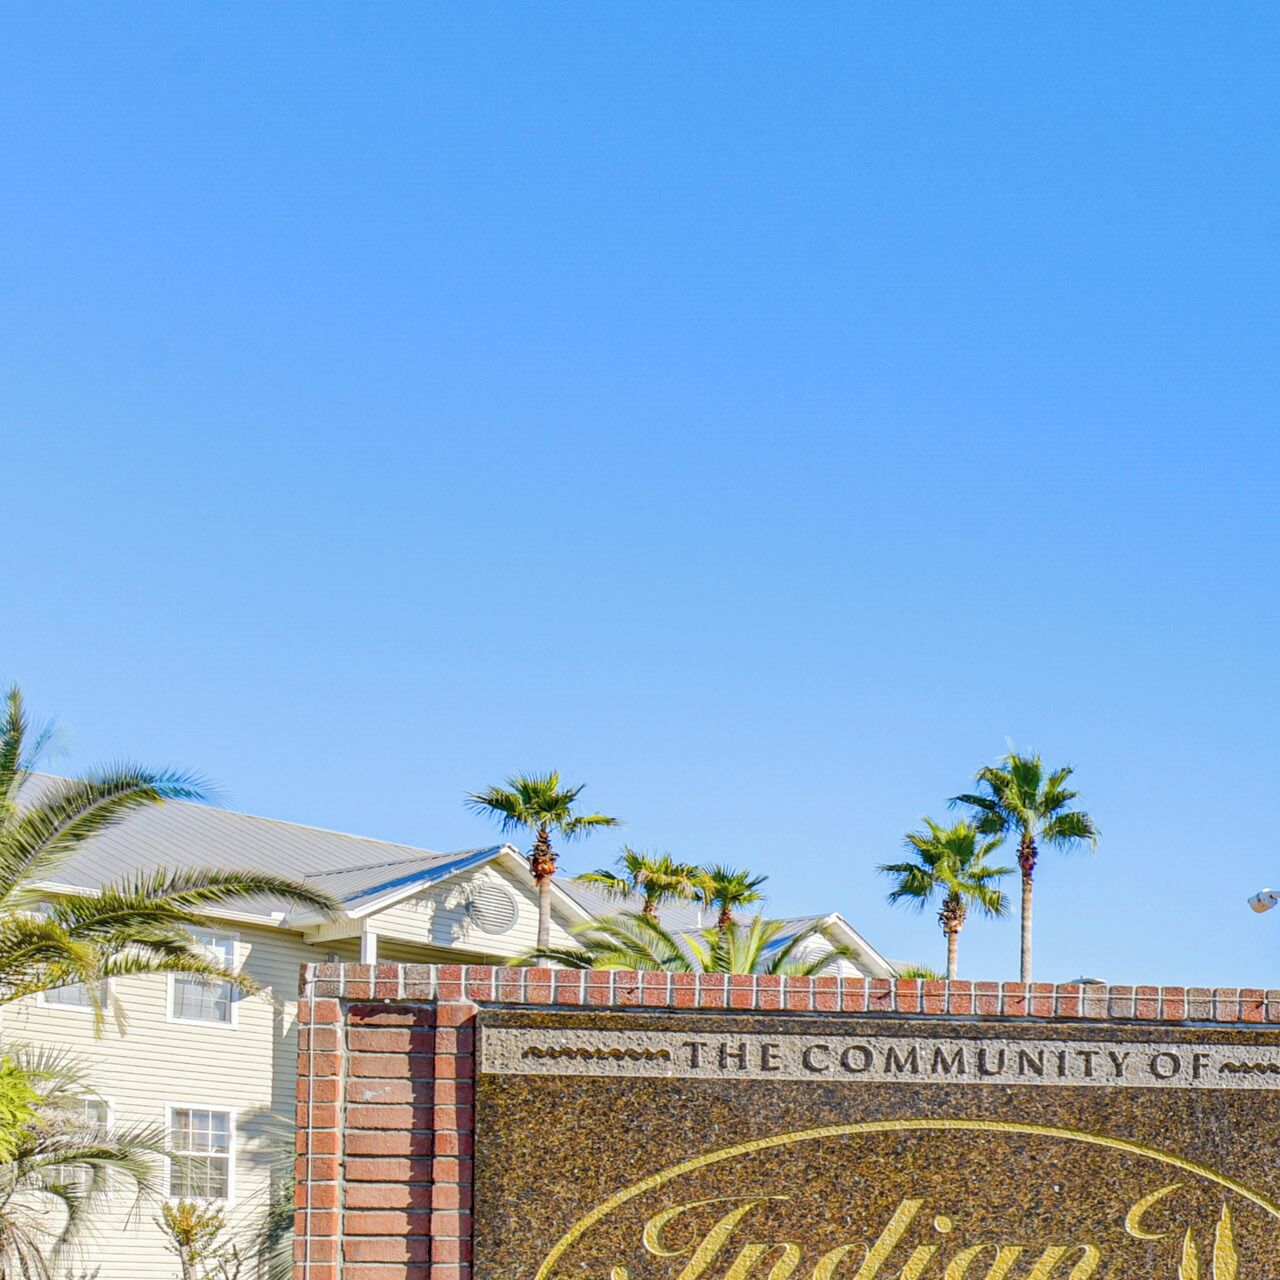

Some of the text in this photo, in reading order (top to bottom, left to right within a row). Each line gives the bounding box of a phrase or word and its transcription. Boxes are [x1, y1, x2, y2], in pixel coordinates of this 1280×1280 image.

[683, 1041, 1211, 1080] THE COMMUNITY OF
